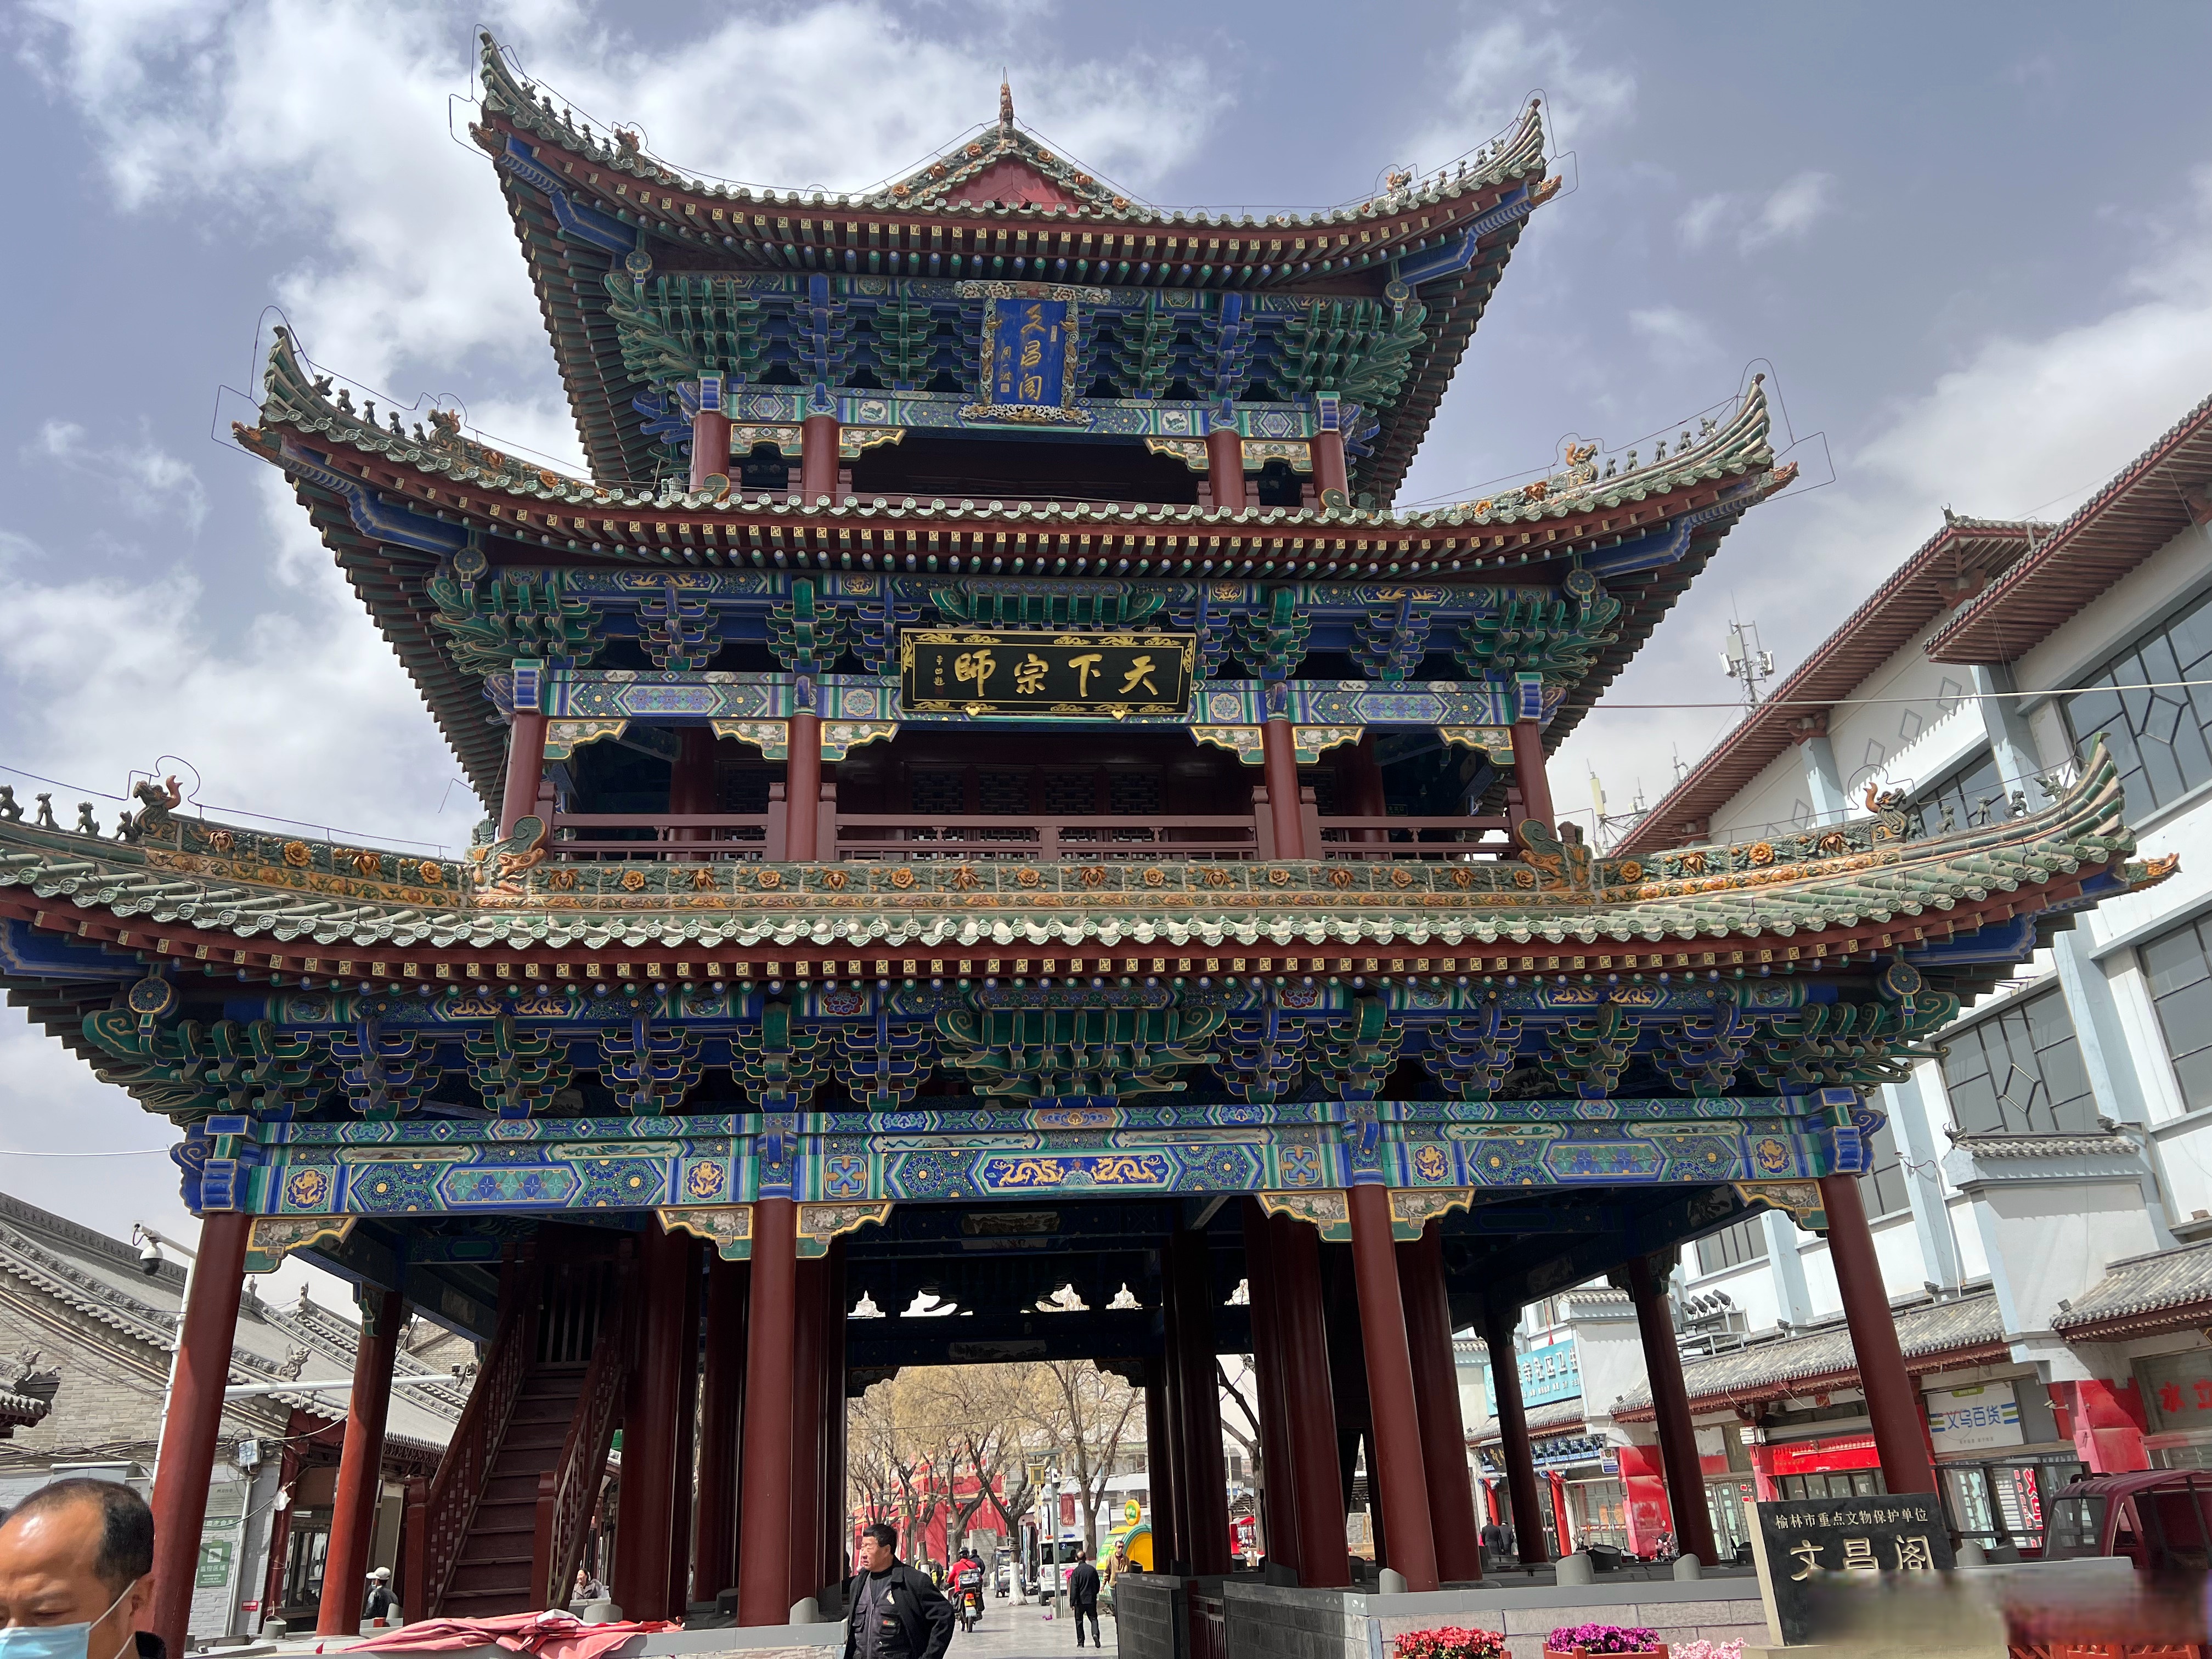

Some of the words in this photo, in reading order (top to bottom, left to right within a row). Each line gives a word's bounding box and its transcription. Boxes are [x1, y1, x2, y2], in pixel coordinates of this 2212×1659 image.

[954, 648, 1159, 697] 天下宗師
[1517, 1347, 1577, 1384] 寺社区卫生
[1947, 1405, 2001, 1430] 义乌百货
[1775, 1507, 1928, 1530] 榆林市重点文物保护单位
[1790, 1534, 1935, 1581] 文昌阁
